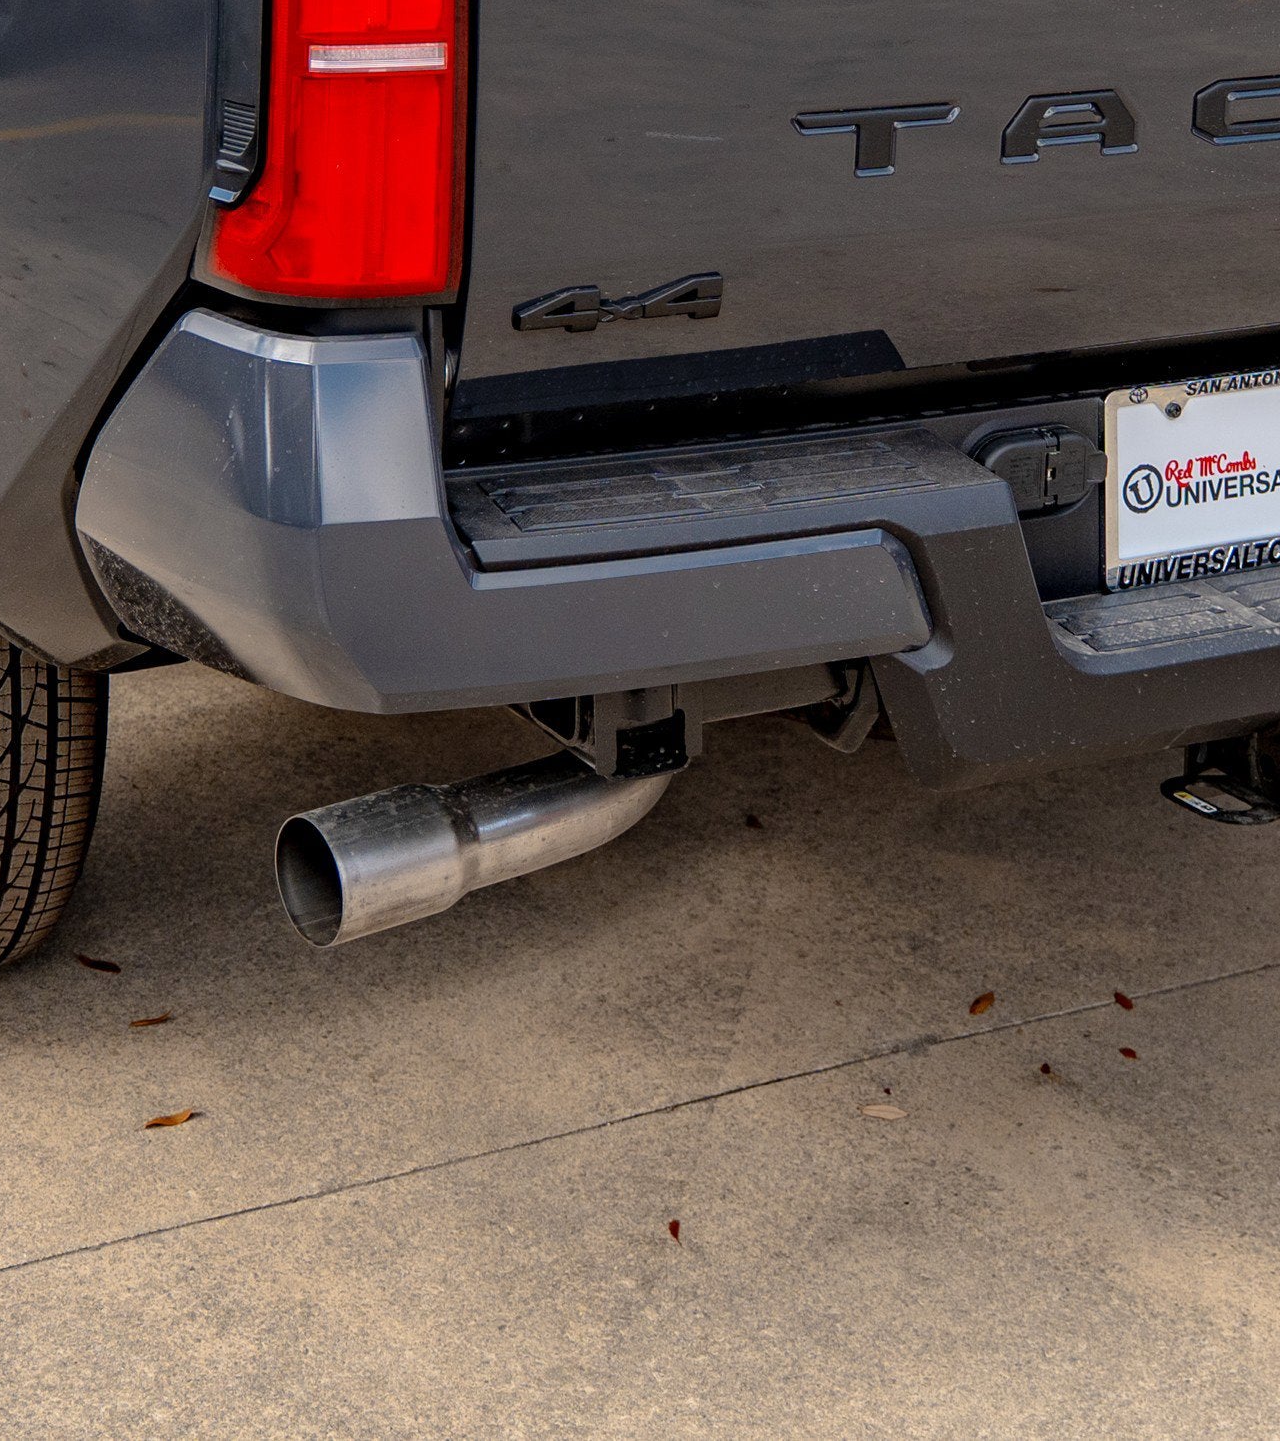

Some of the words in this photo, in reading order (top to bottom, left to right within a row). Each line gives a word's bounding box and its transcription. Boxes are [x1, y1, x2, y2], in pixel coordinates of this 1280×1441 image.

[1185, 379, 1222, 397] SAN
[1165, 458, 1195, 489] Red
[1194, 450, 1257, 478] McCombs
